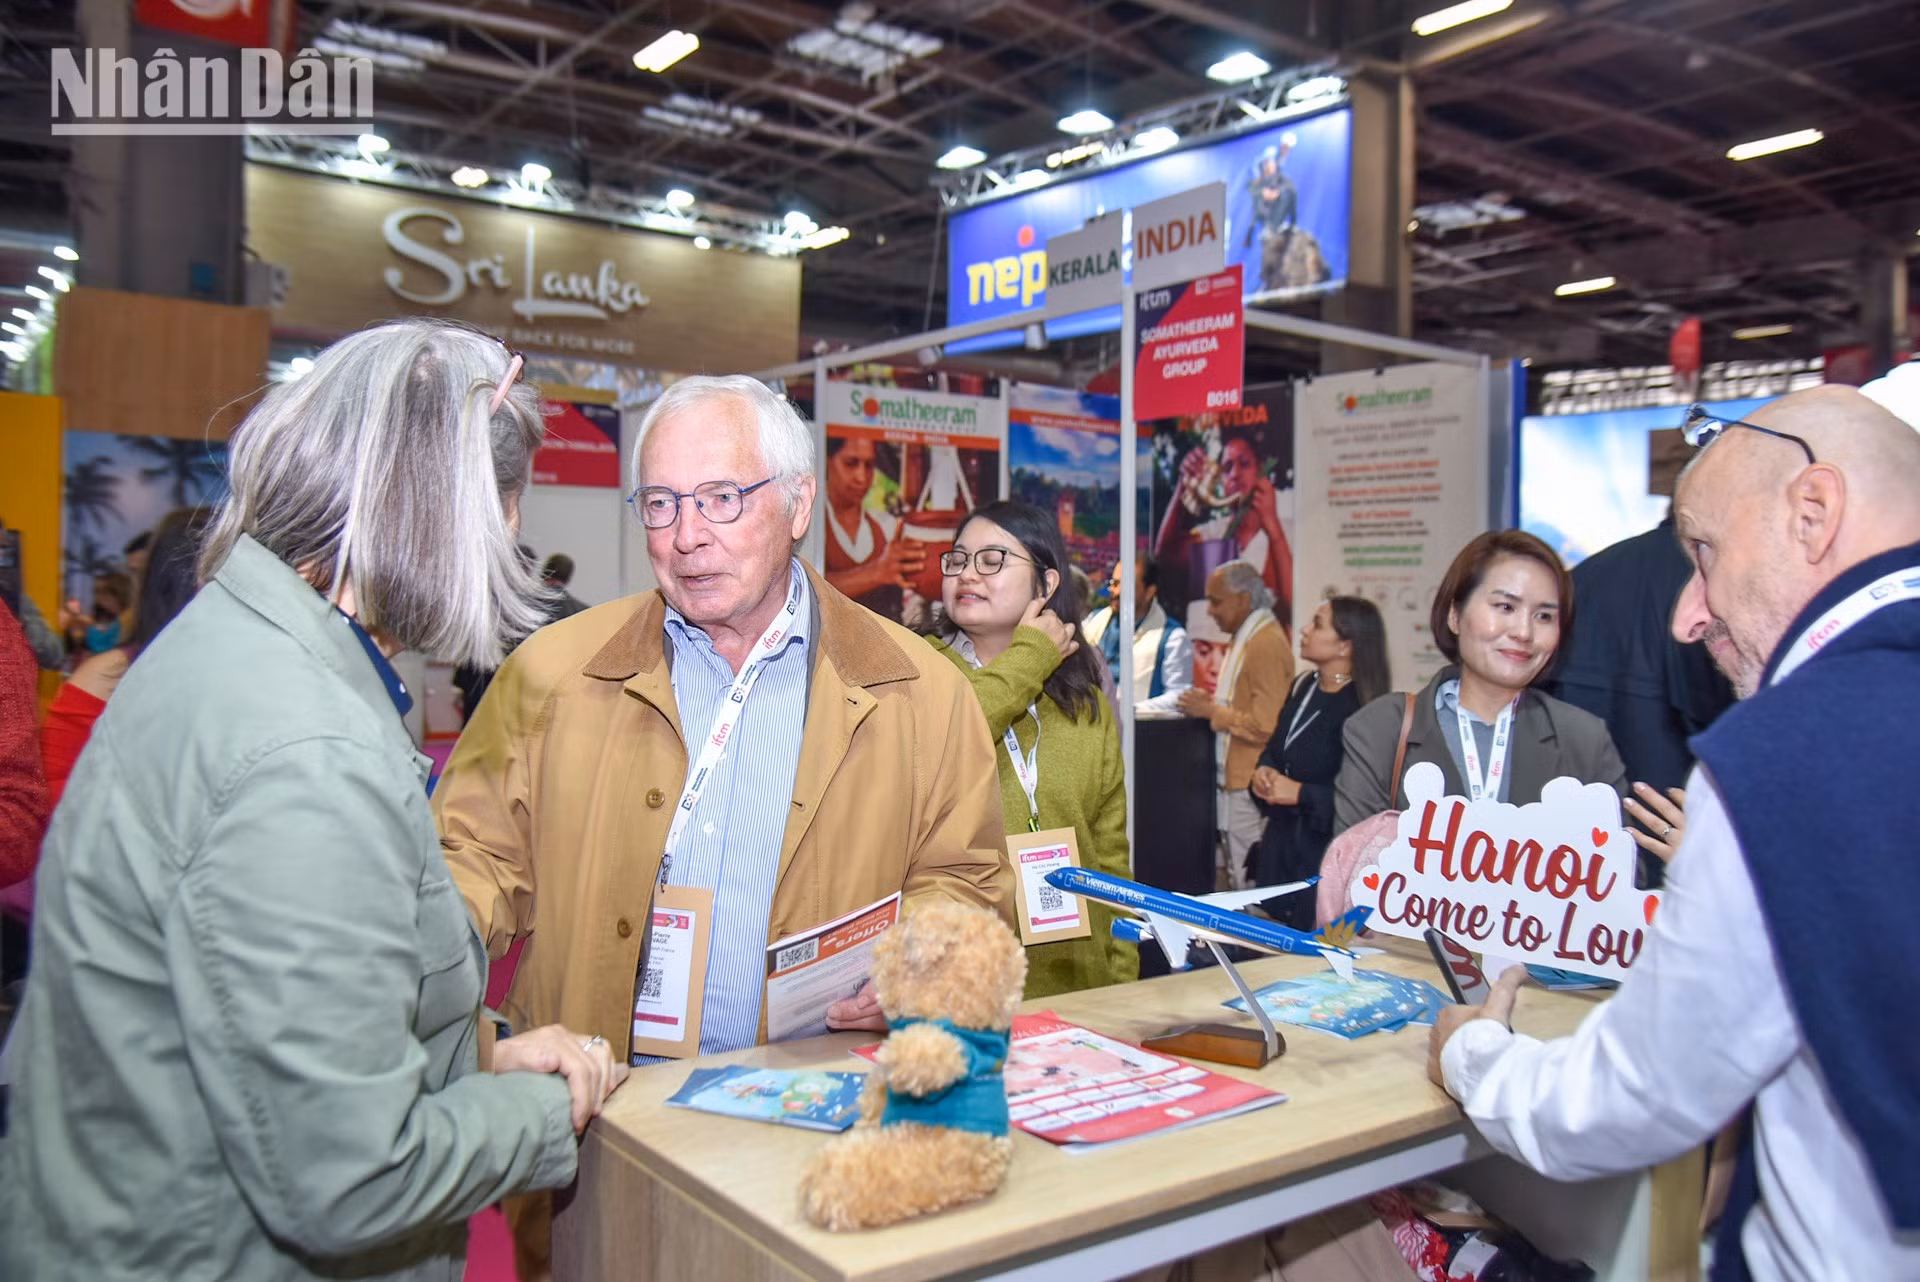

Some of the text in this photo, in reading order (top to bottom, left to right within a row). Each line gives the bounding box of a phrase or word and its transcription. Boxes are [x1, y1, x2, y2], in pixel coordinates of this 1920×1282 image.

[1137, 210, 1217, 261] INDIA
[384, 207, 650, 320] Sri Lanka
[966, 250, 1047, 307] nep
[1049, 248, 1119, 288] KERALA
[1140, 311, 1236, 345] SOMATHEERAM
[1153, 335, 1219, 362] AYURVEDA
[1162, 357, 1208, 379] GROUP
[850, 388, 977, 424] Somatheeram
[760, 629, 782, 651] iftm
[711, 722, 731, 747] iftm
[1408, 800, 1618, 903] Hanoi
[835, 919, 889, 949] Offers
[1378, 872, 1644, 969] Come to Lov
